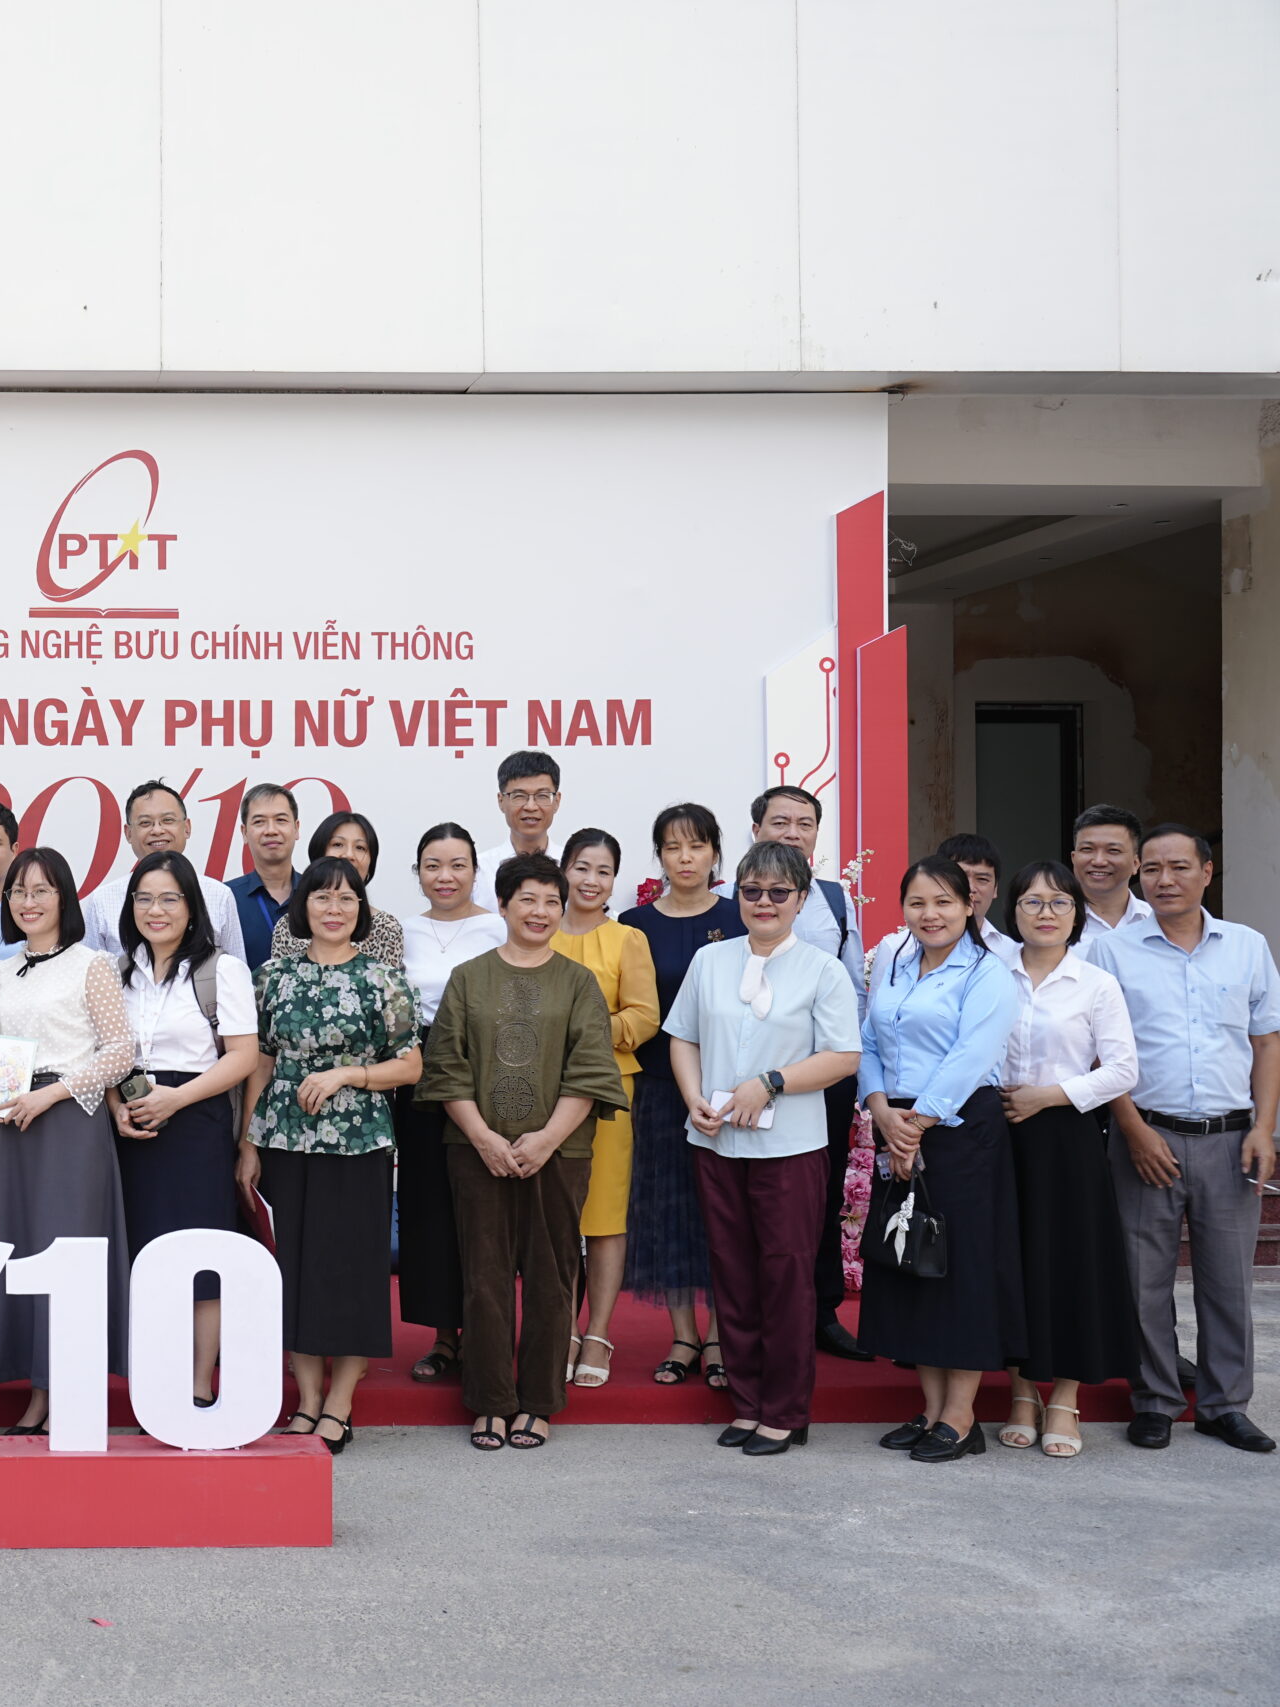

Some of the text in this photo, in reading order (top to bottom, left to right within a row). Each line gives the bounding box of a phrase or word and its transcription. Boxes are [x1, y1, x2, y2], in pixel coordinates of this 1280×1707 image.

[58, 532, 178, 571] PTIT
[21, 623, 104, 665] NGHỆ
[114, 629, 179, 660] BƯU
[190, 624, 283, 660] CHÍNH
[293, 619, 361, 660] VIỄN
[371, 624, 474, 661] THÔNG
[164, 699, 273, 759] PHỤ
[294, 687, 375, 748] NỮ
[388, 687, 509, 759] VIỆT
[527, 698, 653, 747] NAM
